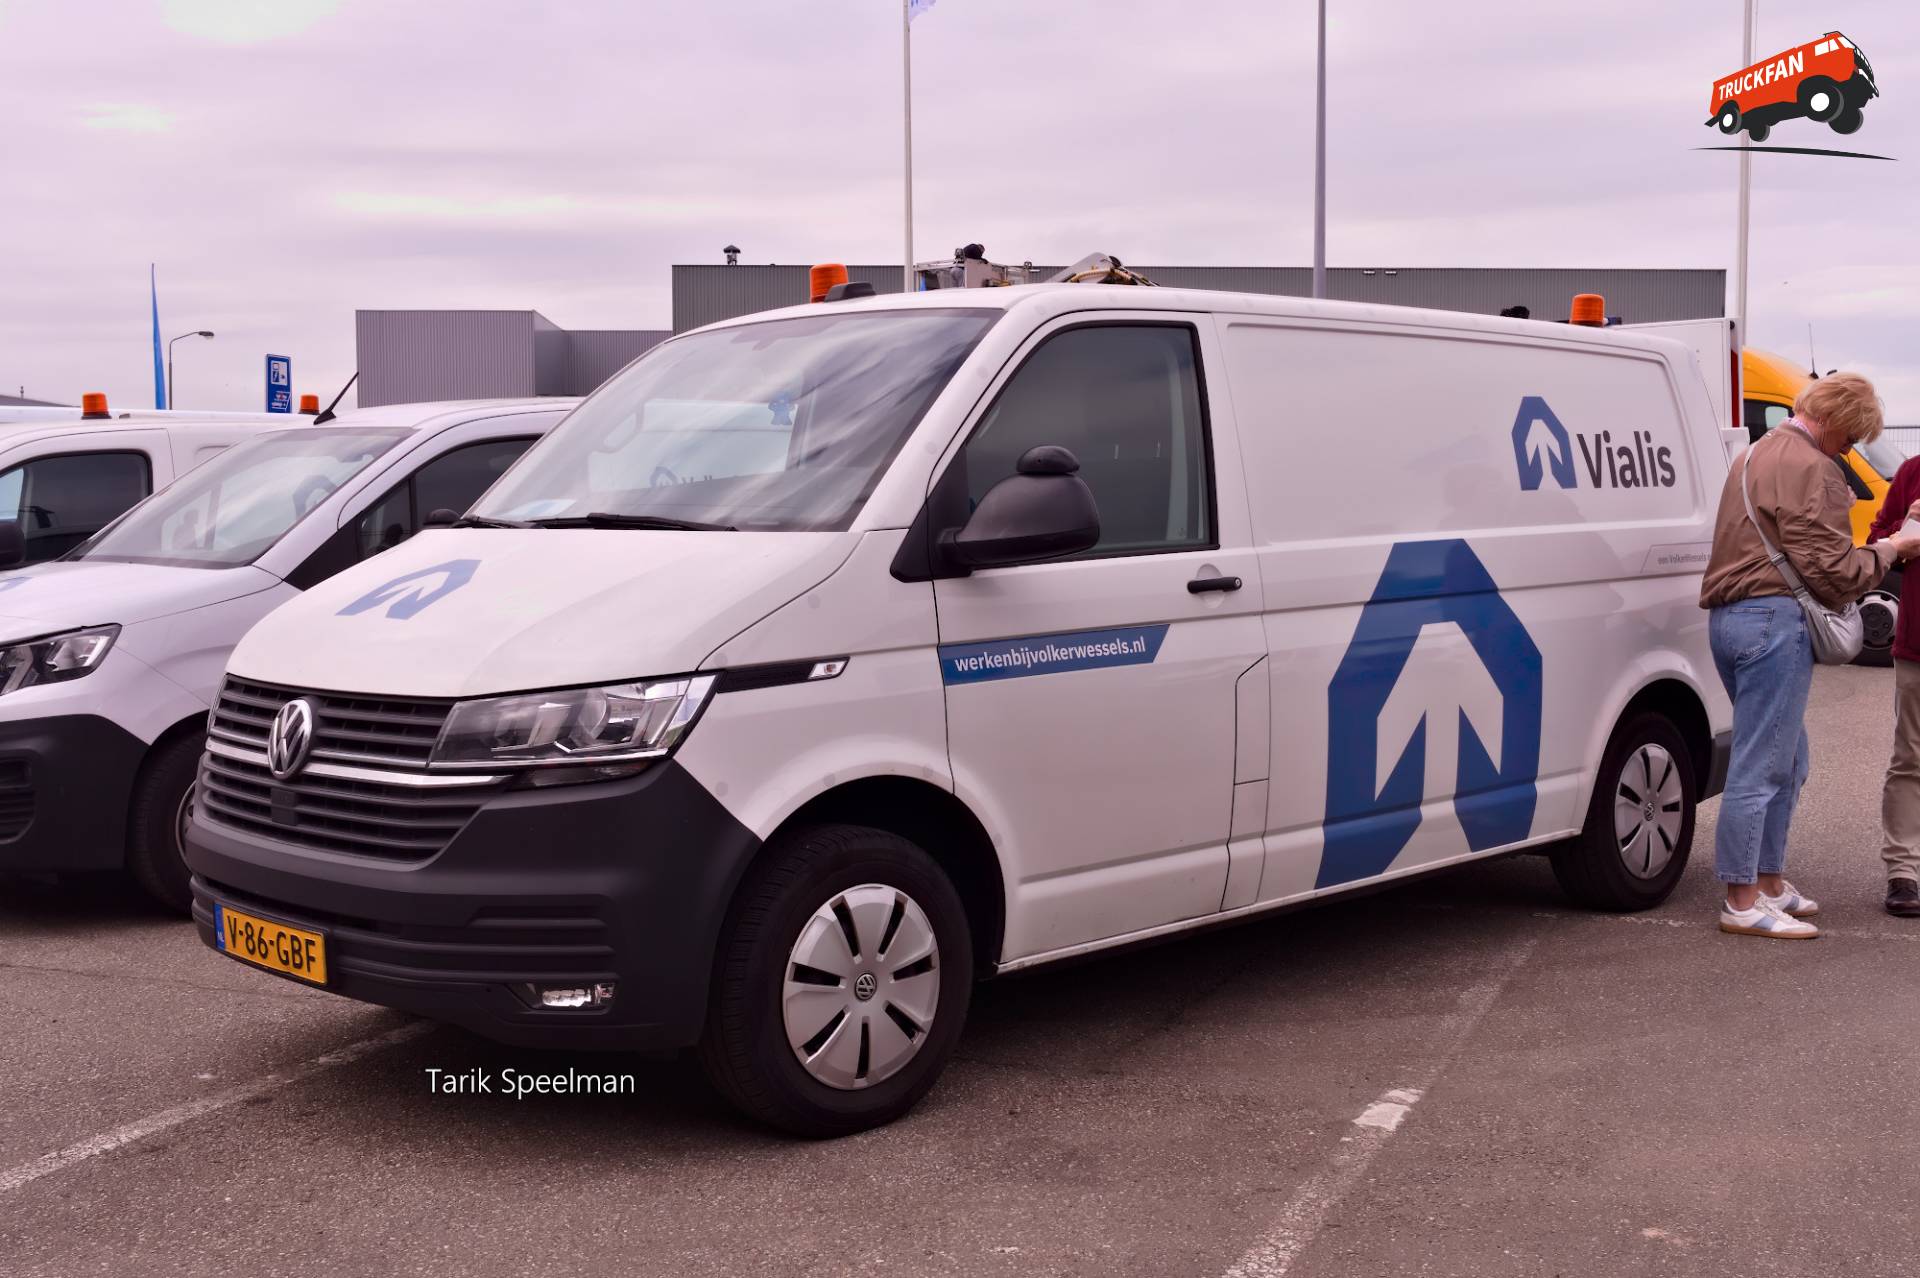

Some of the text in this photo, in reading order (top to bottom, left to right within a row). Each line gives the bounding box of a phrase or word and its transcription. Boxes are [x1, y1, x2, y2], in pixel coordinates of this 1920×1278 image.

[1576, 430, 1676, 488] Vialis
[954, 636, 1147, 672] werkenbijvolkerwessels.nl
[227, 915, 316, 973] V-86-GBF
